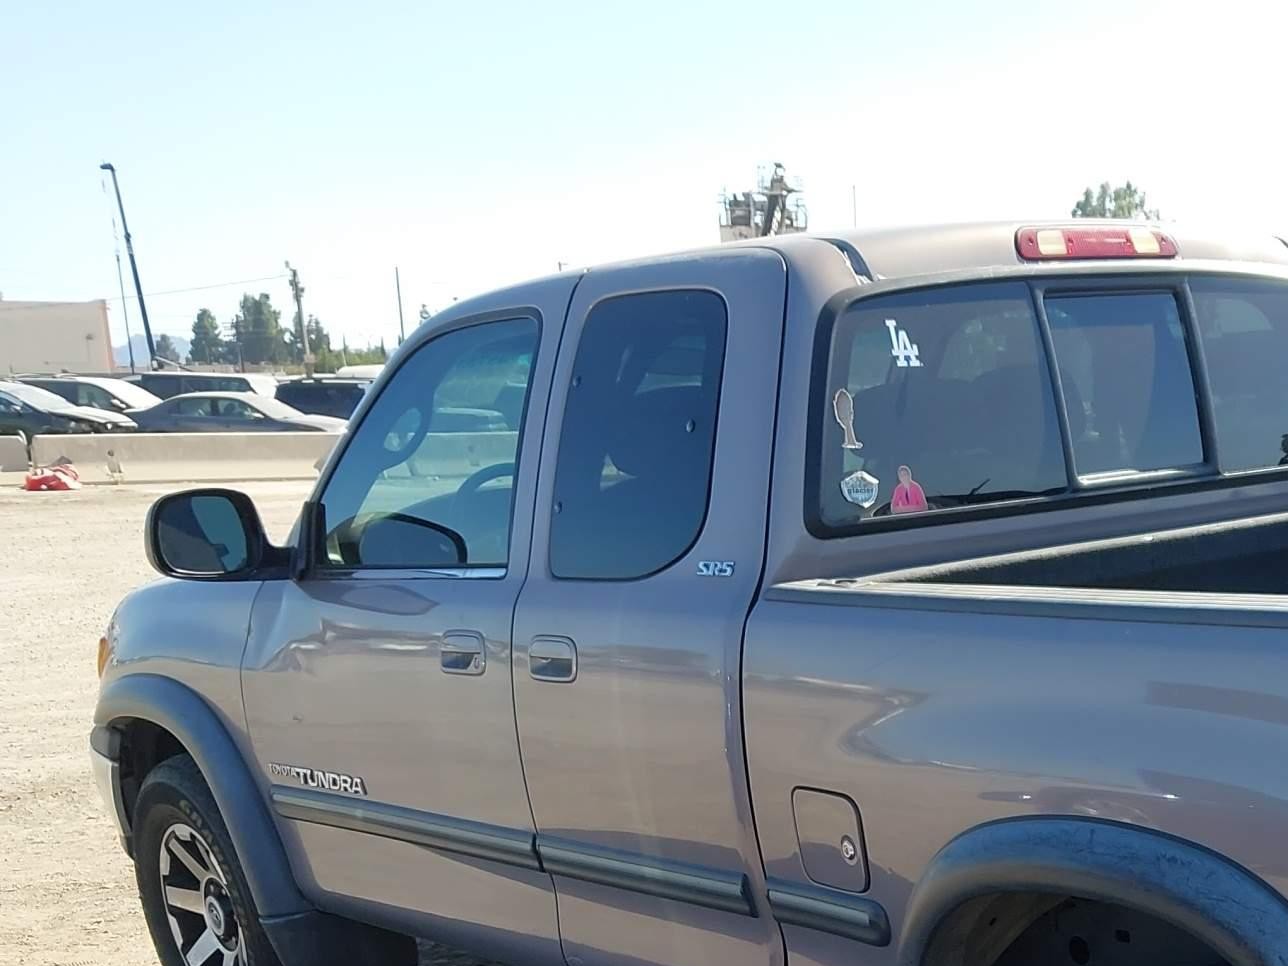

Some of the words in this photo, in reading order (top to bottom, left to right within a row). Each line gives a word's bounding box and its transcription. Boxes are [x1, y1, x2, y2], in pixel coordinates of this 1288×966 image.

[884, 318, 922, 368] LA
[696, 560, 735, 577] SR5
[268, 763, 297, 777] TOYOTA
[295, 768, 367, 795] TUNDRA
